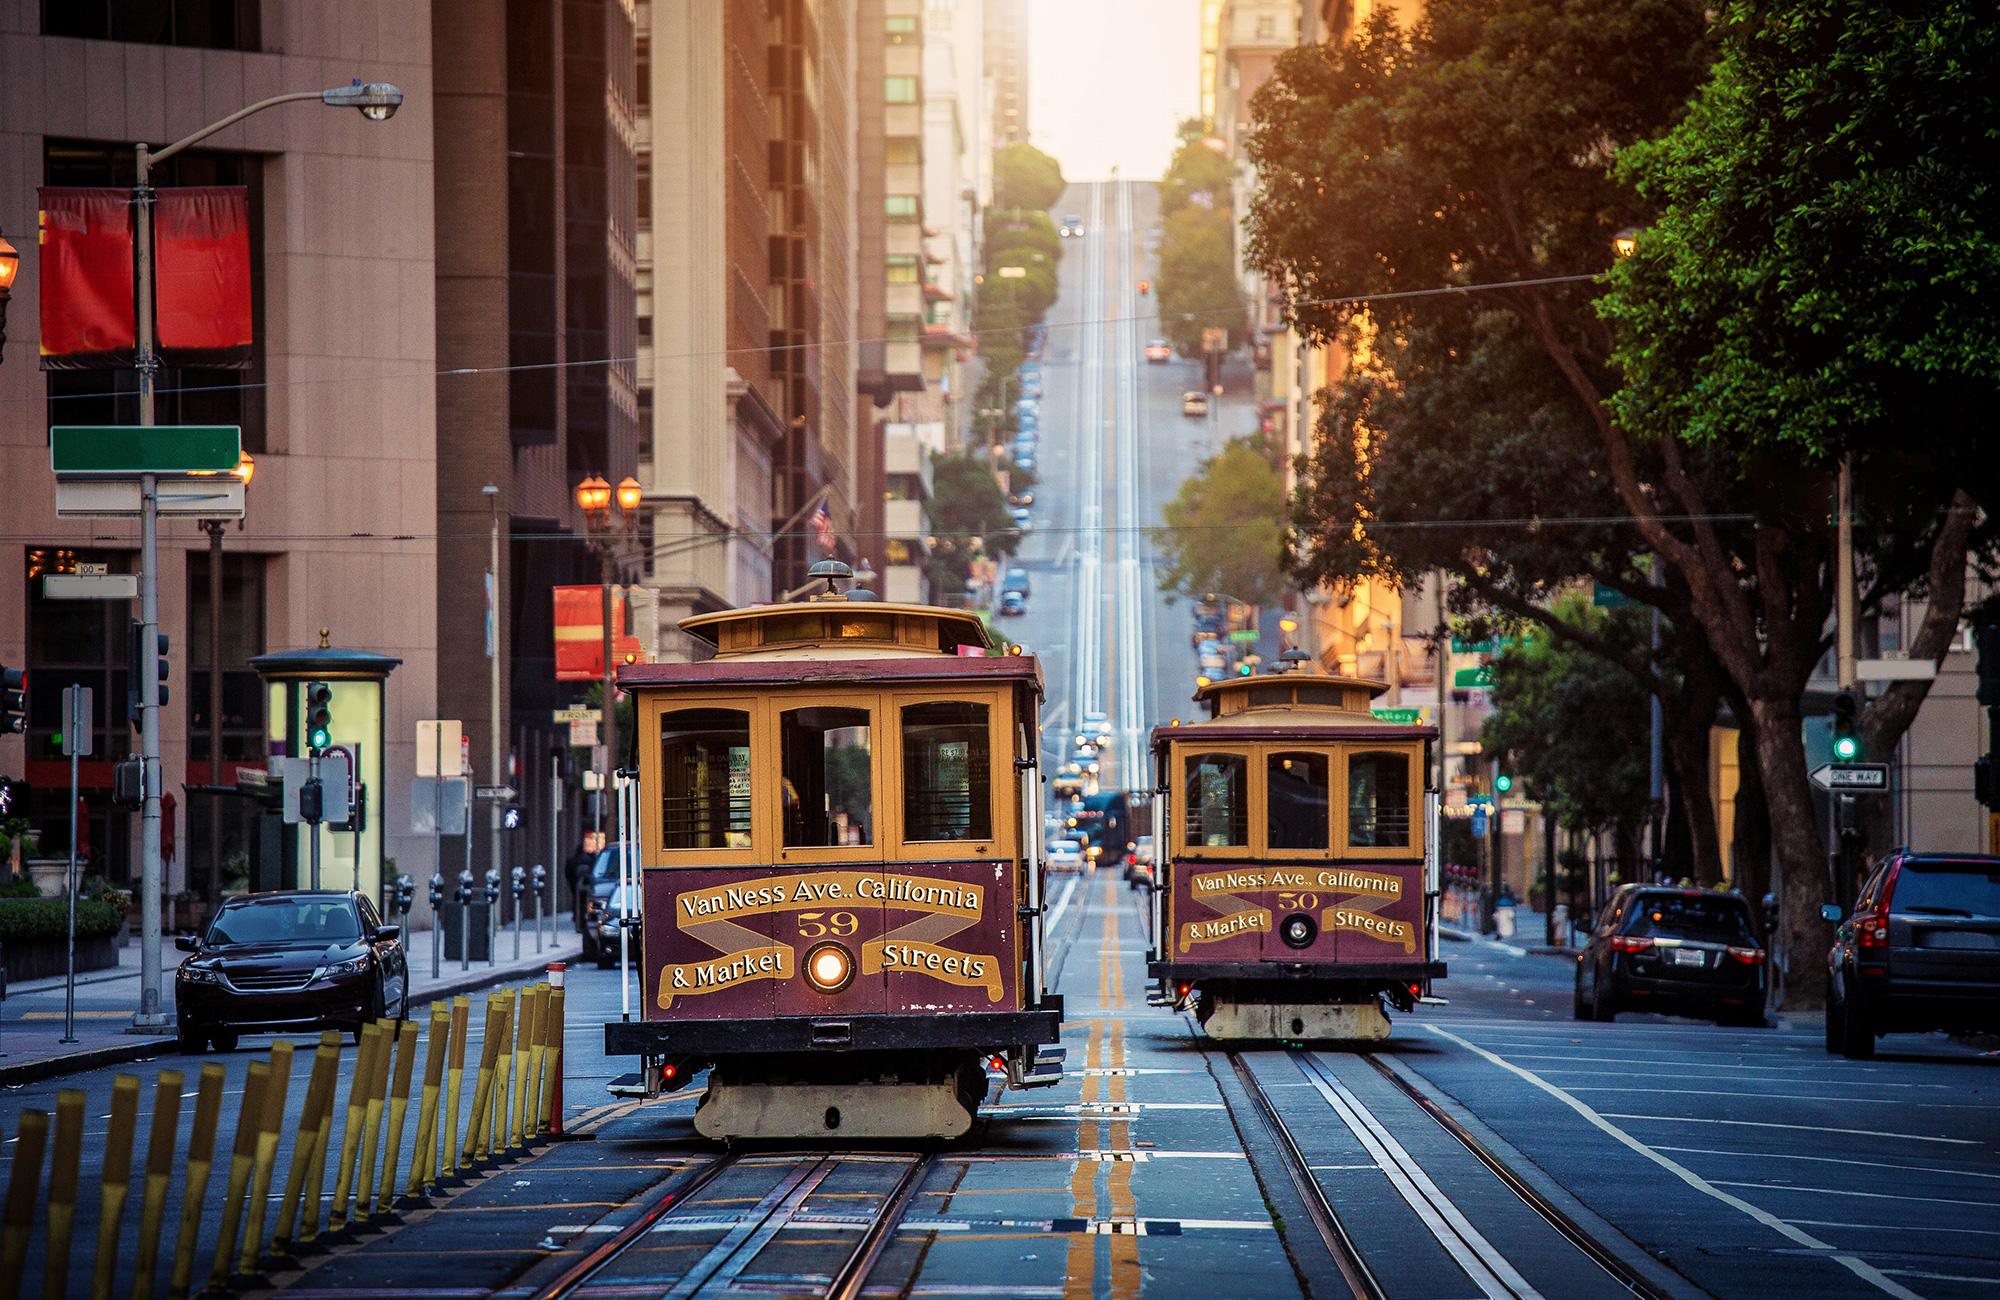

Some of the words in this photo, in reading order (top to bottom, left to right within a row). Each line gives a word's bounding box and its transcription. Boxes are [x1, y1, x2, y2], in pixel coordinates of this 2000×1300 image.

[80, 565, 94, 574] 100
[561, 711, 594, 719] FRONT
[731, 753, 746, 762] WAY
[1831, 770, 1852, 781] ONE
[1855, 770, 1878, 781] WAY
[1196, 876, 1224, 891] Van
[1226, 872, 1267, 888] Ness
[1317, 871, 1399, 893] California
[681, 894, 725, 918] Van
[725, 886, 786, 911] Ness
[856, 877, 979, 910] California
[1278, 892, 1319, 910] 50
[798, 911, 859, 938] 59
[1190, 924, 1203, 938] &
[1204, 912, 1265, 938] Market
[1335, 911, 1405, 937] Streets
[672, 967, 691, 989] &
[694, 951, 783, 989] Market
[881, 944, 986, 979] Streets
